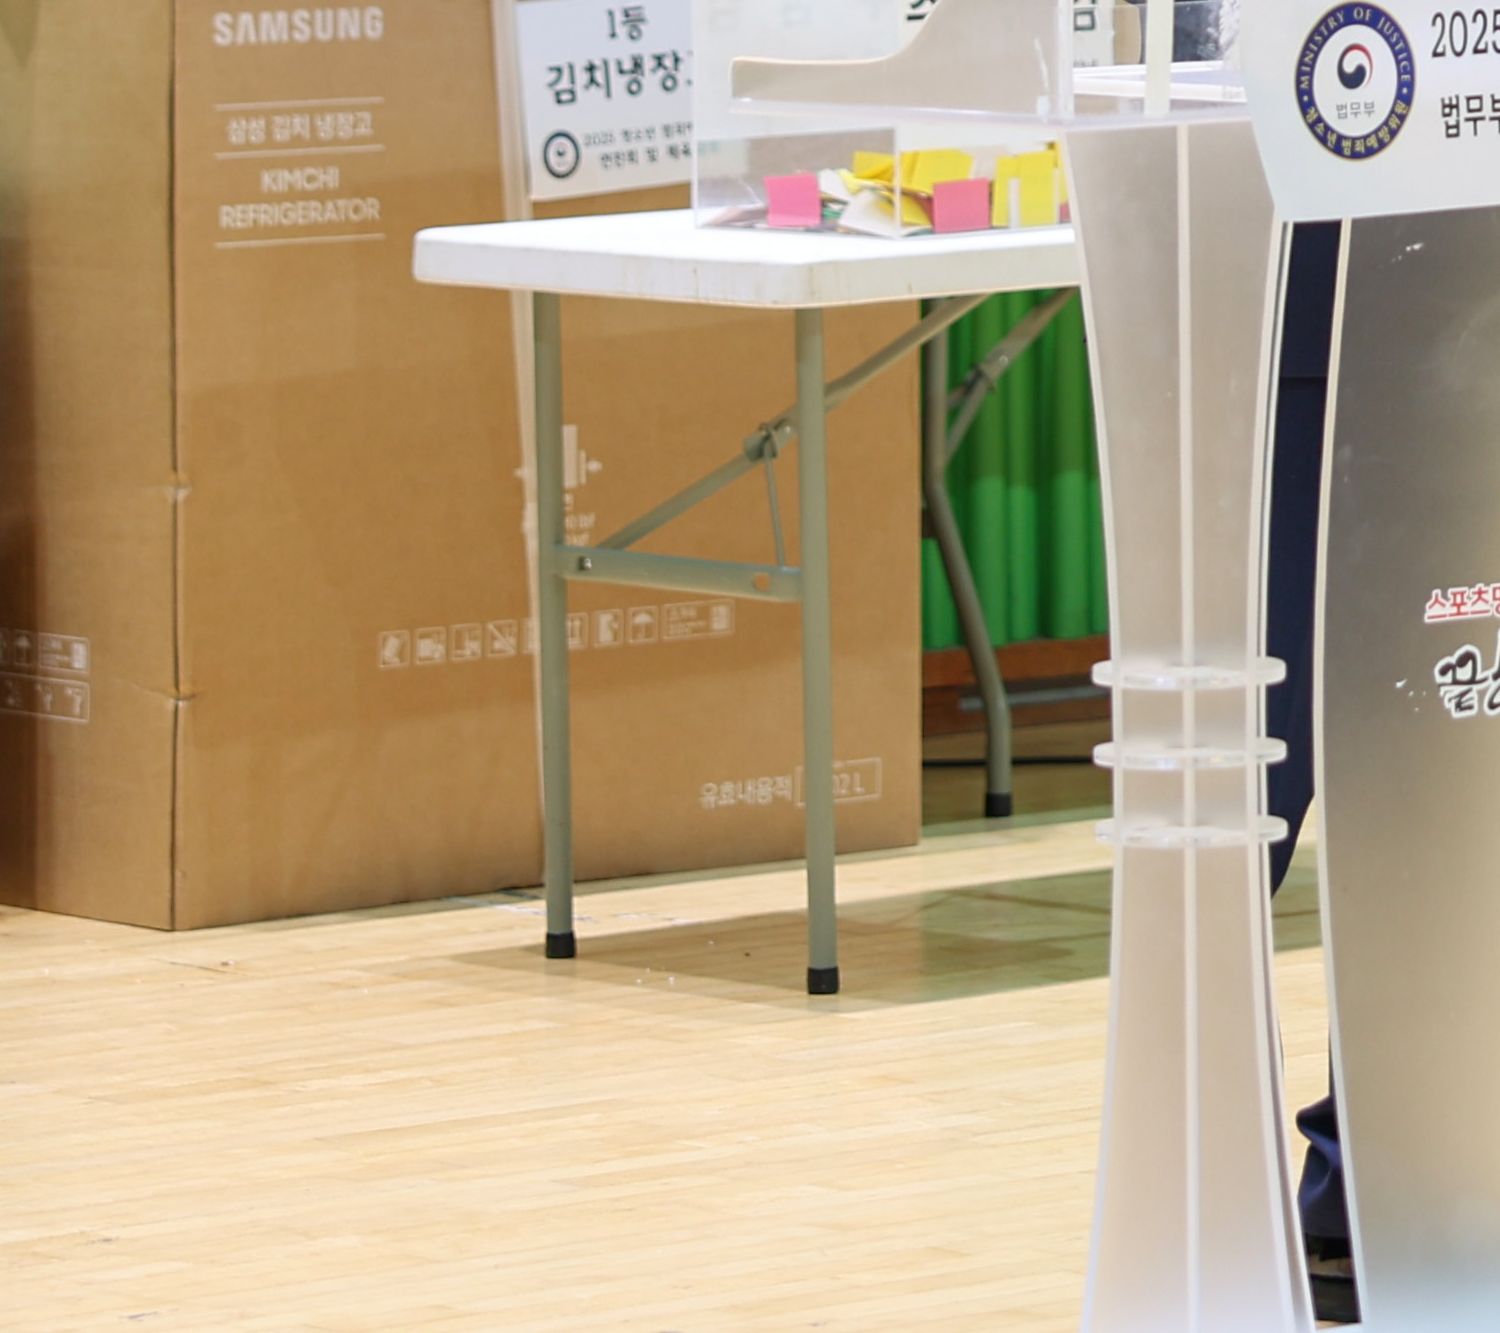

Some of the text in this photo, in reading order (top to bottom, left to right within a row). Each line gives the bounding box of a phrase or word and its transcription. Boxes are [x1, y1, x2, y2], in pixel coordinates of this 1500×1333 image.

[213, 6, 384, 47] SAMSUNG
[606, 6, 648, 41] 1등
[1300, 6, 1412, 90] MINISTRY OF JUSTICE
[547, 50, 694, 105] 김치냉장
[229, 110, 374, 145] 삼성 김치 냉장고
[1335, 100, 1377, 120] 법무부
[260, 167, 339, 194] KIMCHI
[219, 198, 381, 230] REFRIGERATOR
[700, 773, 793, 809] 유효내용적
